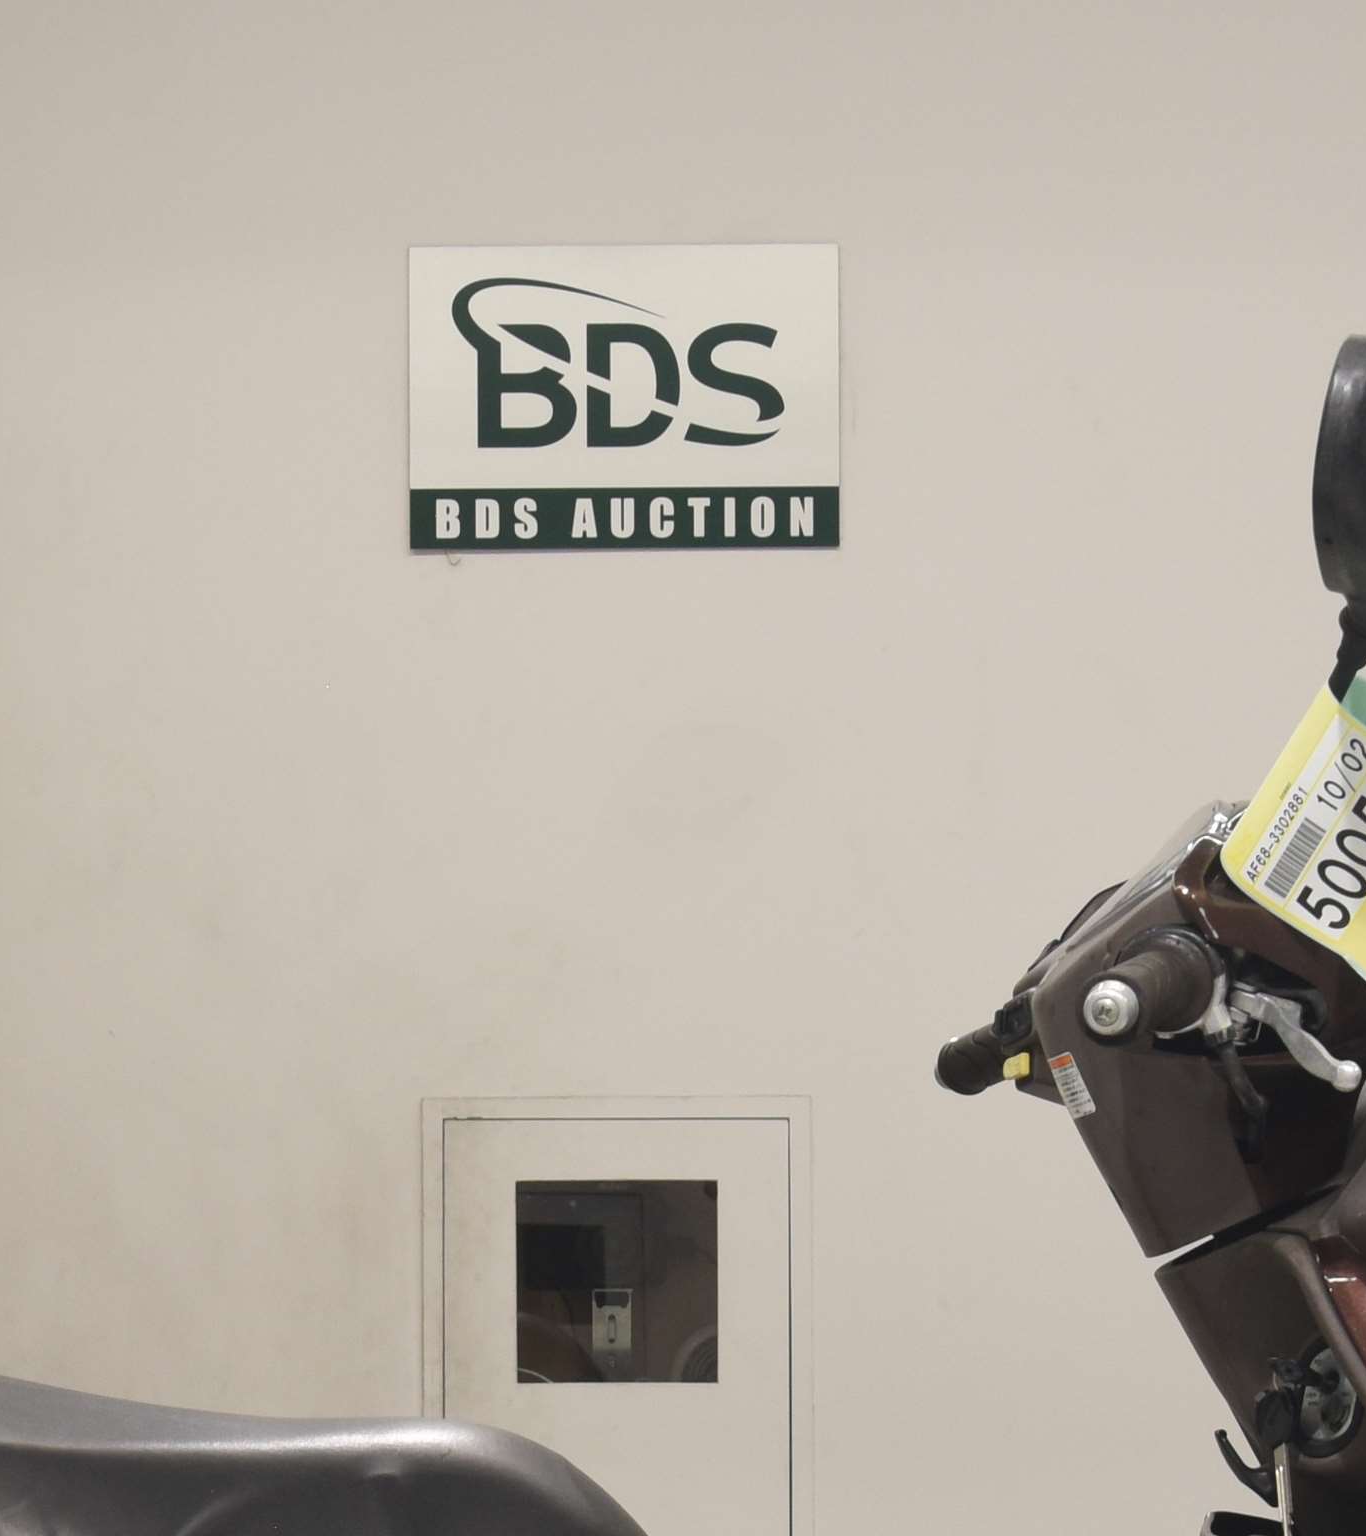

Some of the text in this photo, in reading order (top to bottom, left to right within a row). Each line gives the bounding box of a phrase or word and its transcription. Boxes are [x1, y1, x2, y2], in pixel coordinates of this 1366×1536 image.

[452, 277, 785, 448] BDS
[435, 495, 815, 540] BDS AUCTION
[1245, 786, 1308, 883] AF68-3302881
